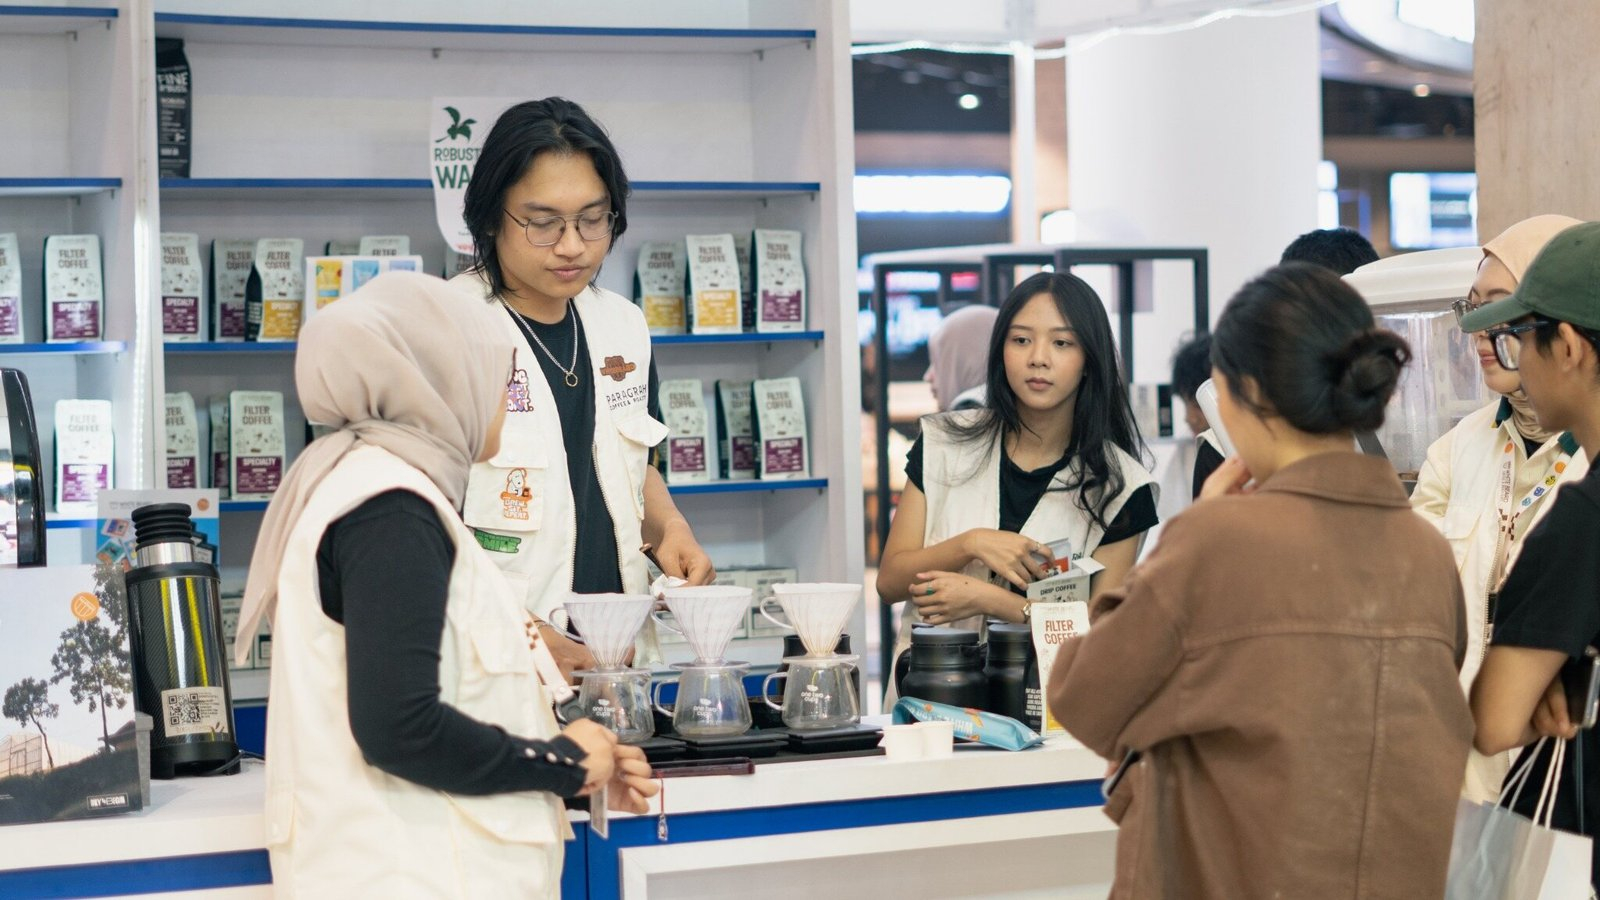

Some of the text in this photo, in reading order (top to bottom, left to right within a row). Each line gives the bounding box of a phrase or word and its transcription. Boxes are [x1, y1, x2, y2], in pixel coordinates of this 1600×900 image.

[243, 405, 271, 415] FILTER
[242, 415, 274, 425] COFFEE
[1055, 583, 1077, 592] COFFEE
[1044, 619, 1074, 632] FILTER
